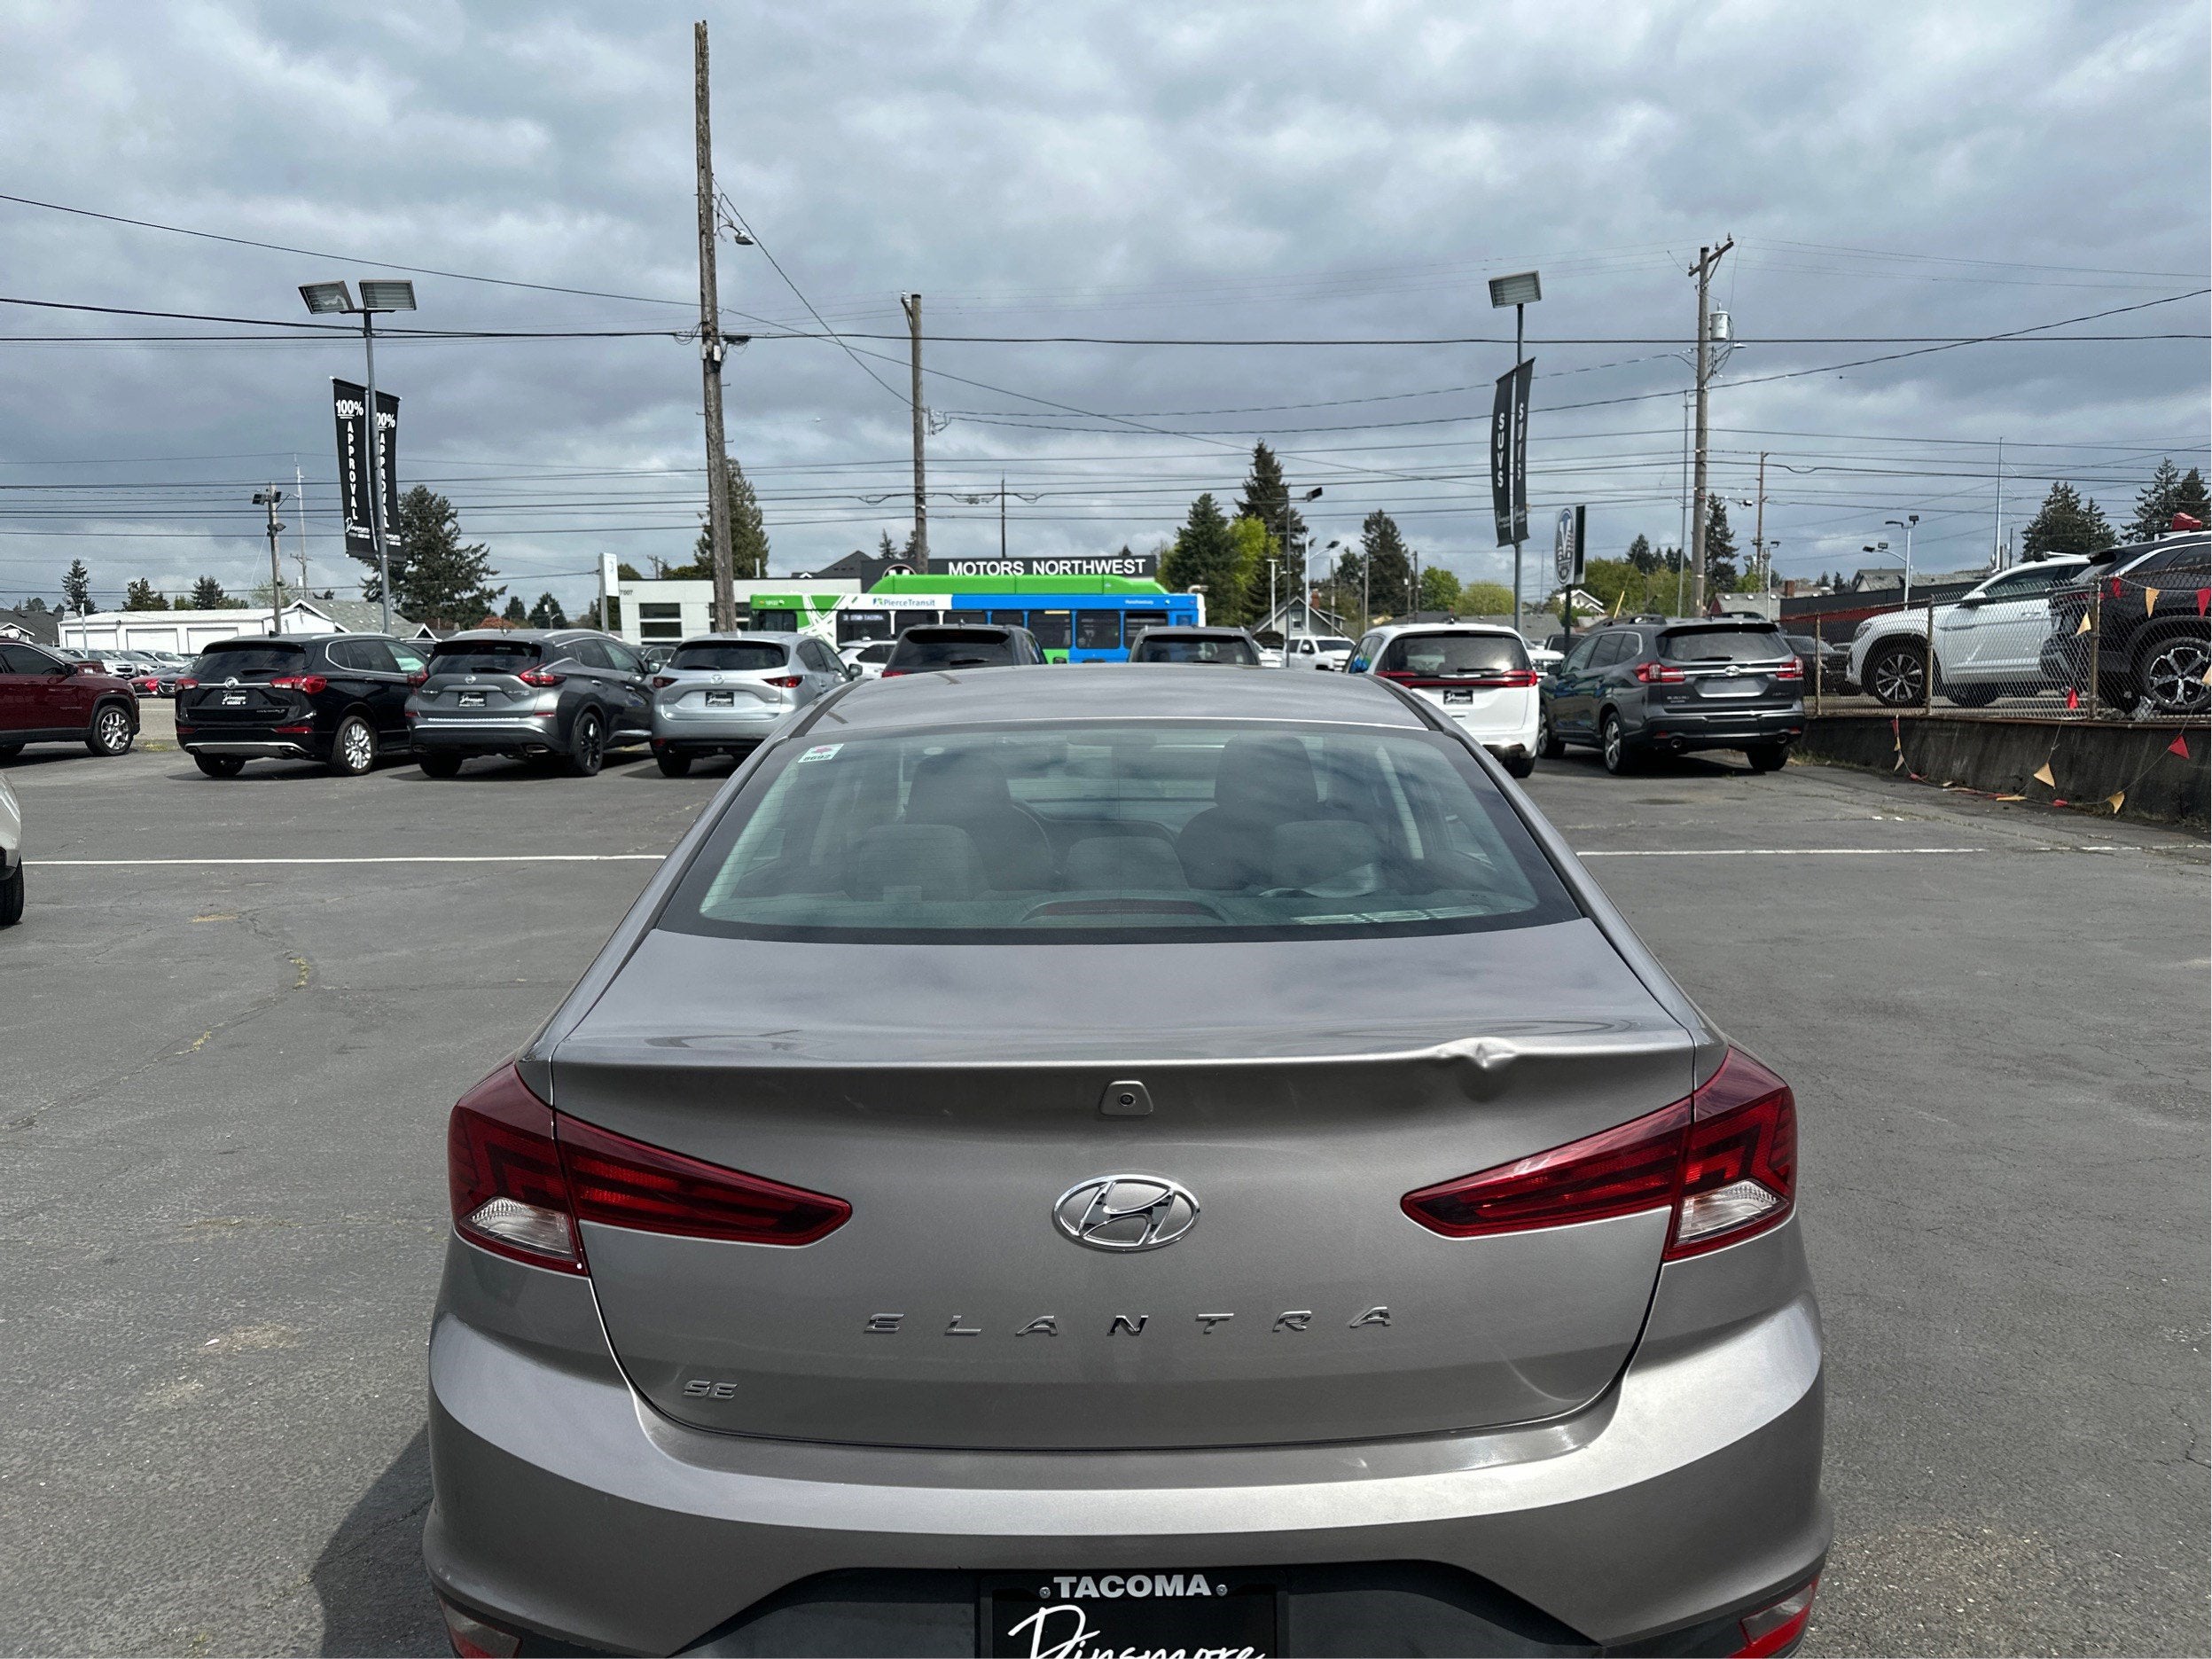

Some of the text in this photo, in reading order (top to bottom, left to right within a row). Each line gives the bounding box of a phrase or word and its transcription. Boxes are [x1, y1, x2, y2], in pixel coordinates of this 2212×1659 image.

[336, 399, 364, 416] 100%
[347, 420, 358, 520] APPROVAL
[948, 559, 1146, 576] MOTORS NORTHWEST
[863, 1305, 1393, 1336] ELANTRA
[682, 1379, 739, 1401] SE
[1053, 1574, 1212, 1599] TACOMA
